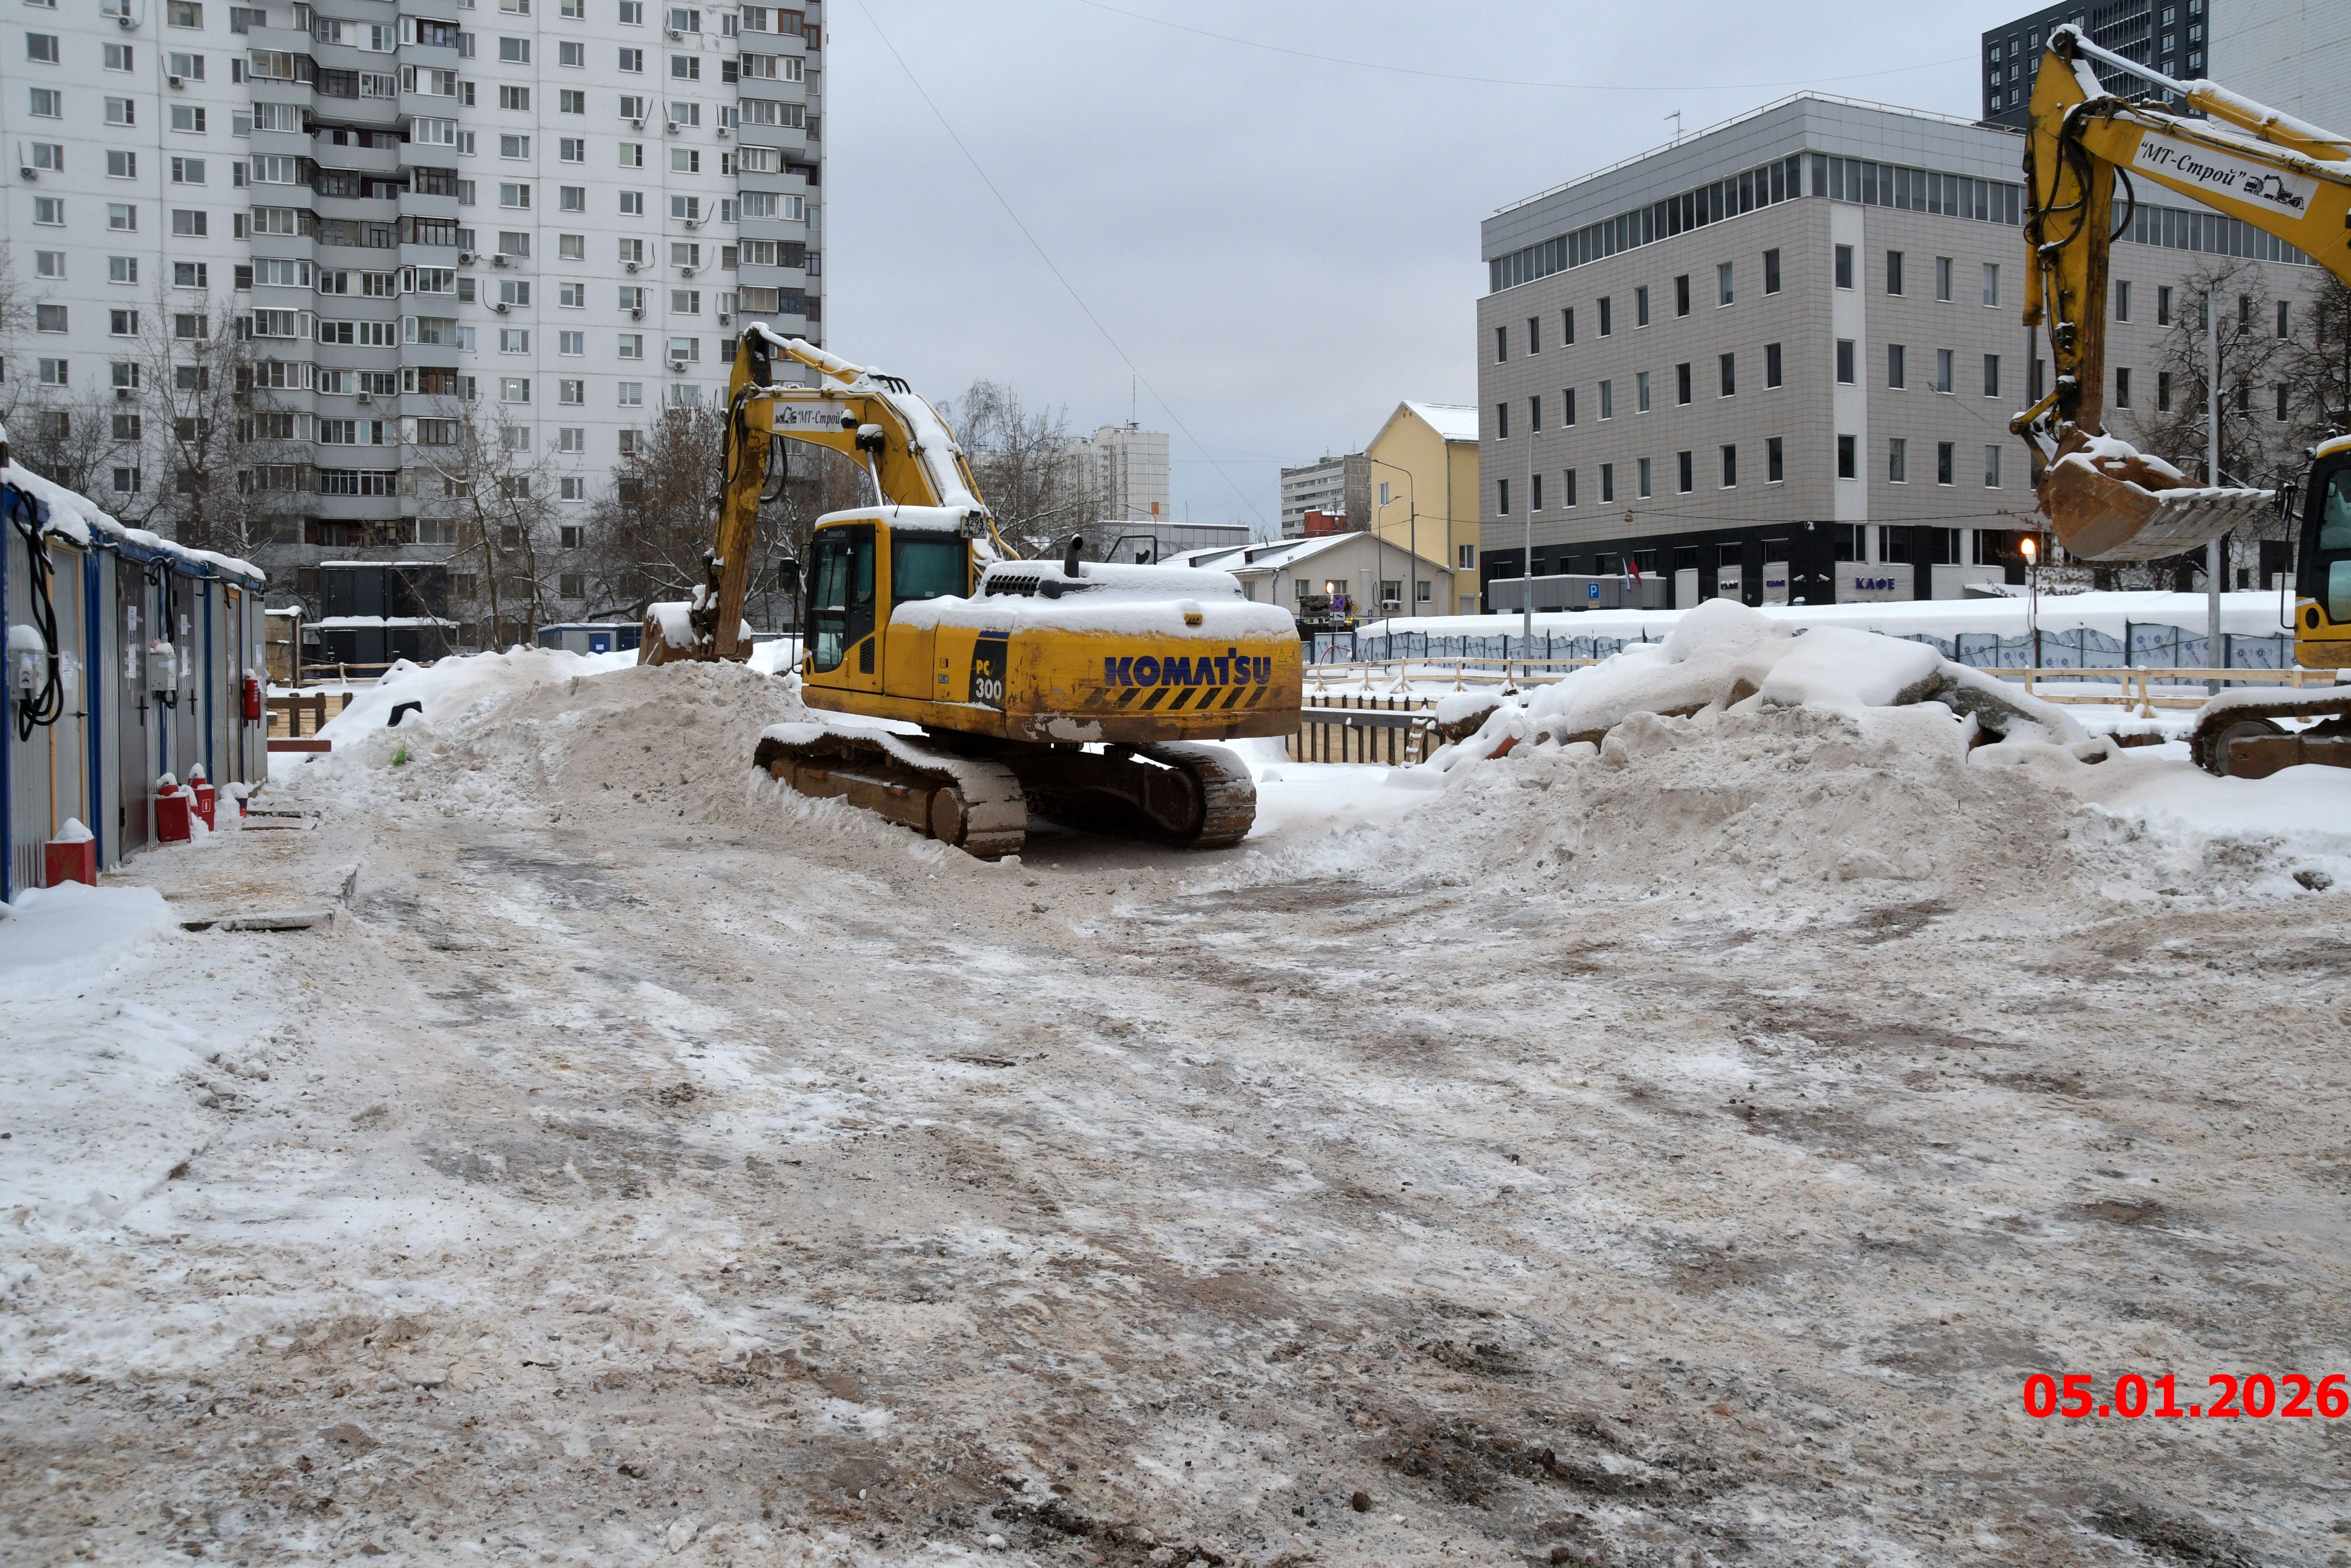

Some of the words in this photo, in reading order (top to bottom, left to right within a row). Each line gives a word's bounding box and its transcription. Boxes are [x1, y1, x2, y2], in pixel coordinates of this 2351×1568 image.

[965, 518, 984, 527] 3295
[1856, 577, 1895, 590] КАФЕ
[976, 659, 990, 676] PC
[1105, 647, 1271, 687] KOMATSU
[975, 678, 1002, 700] 300
